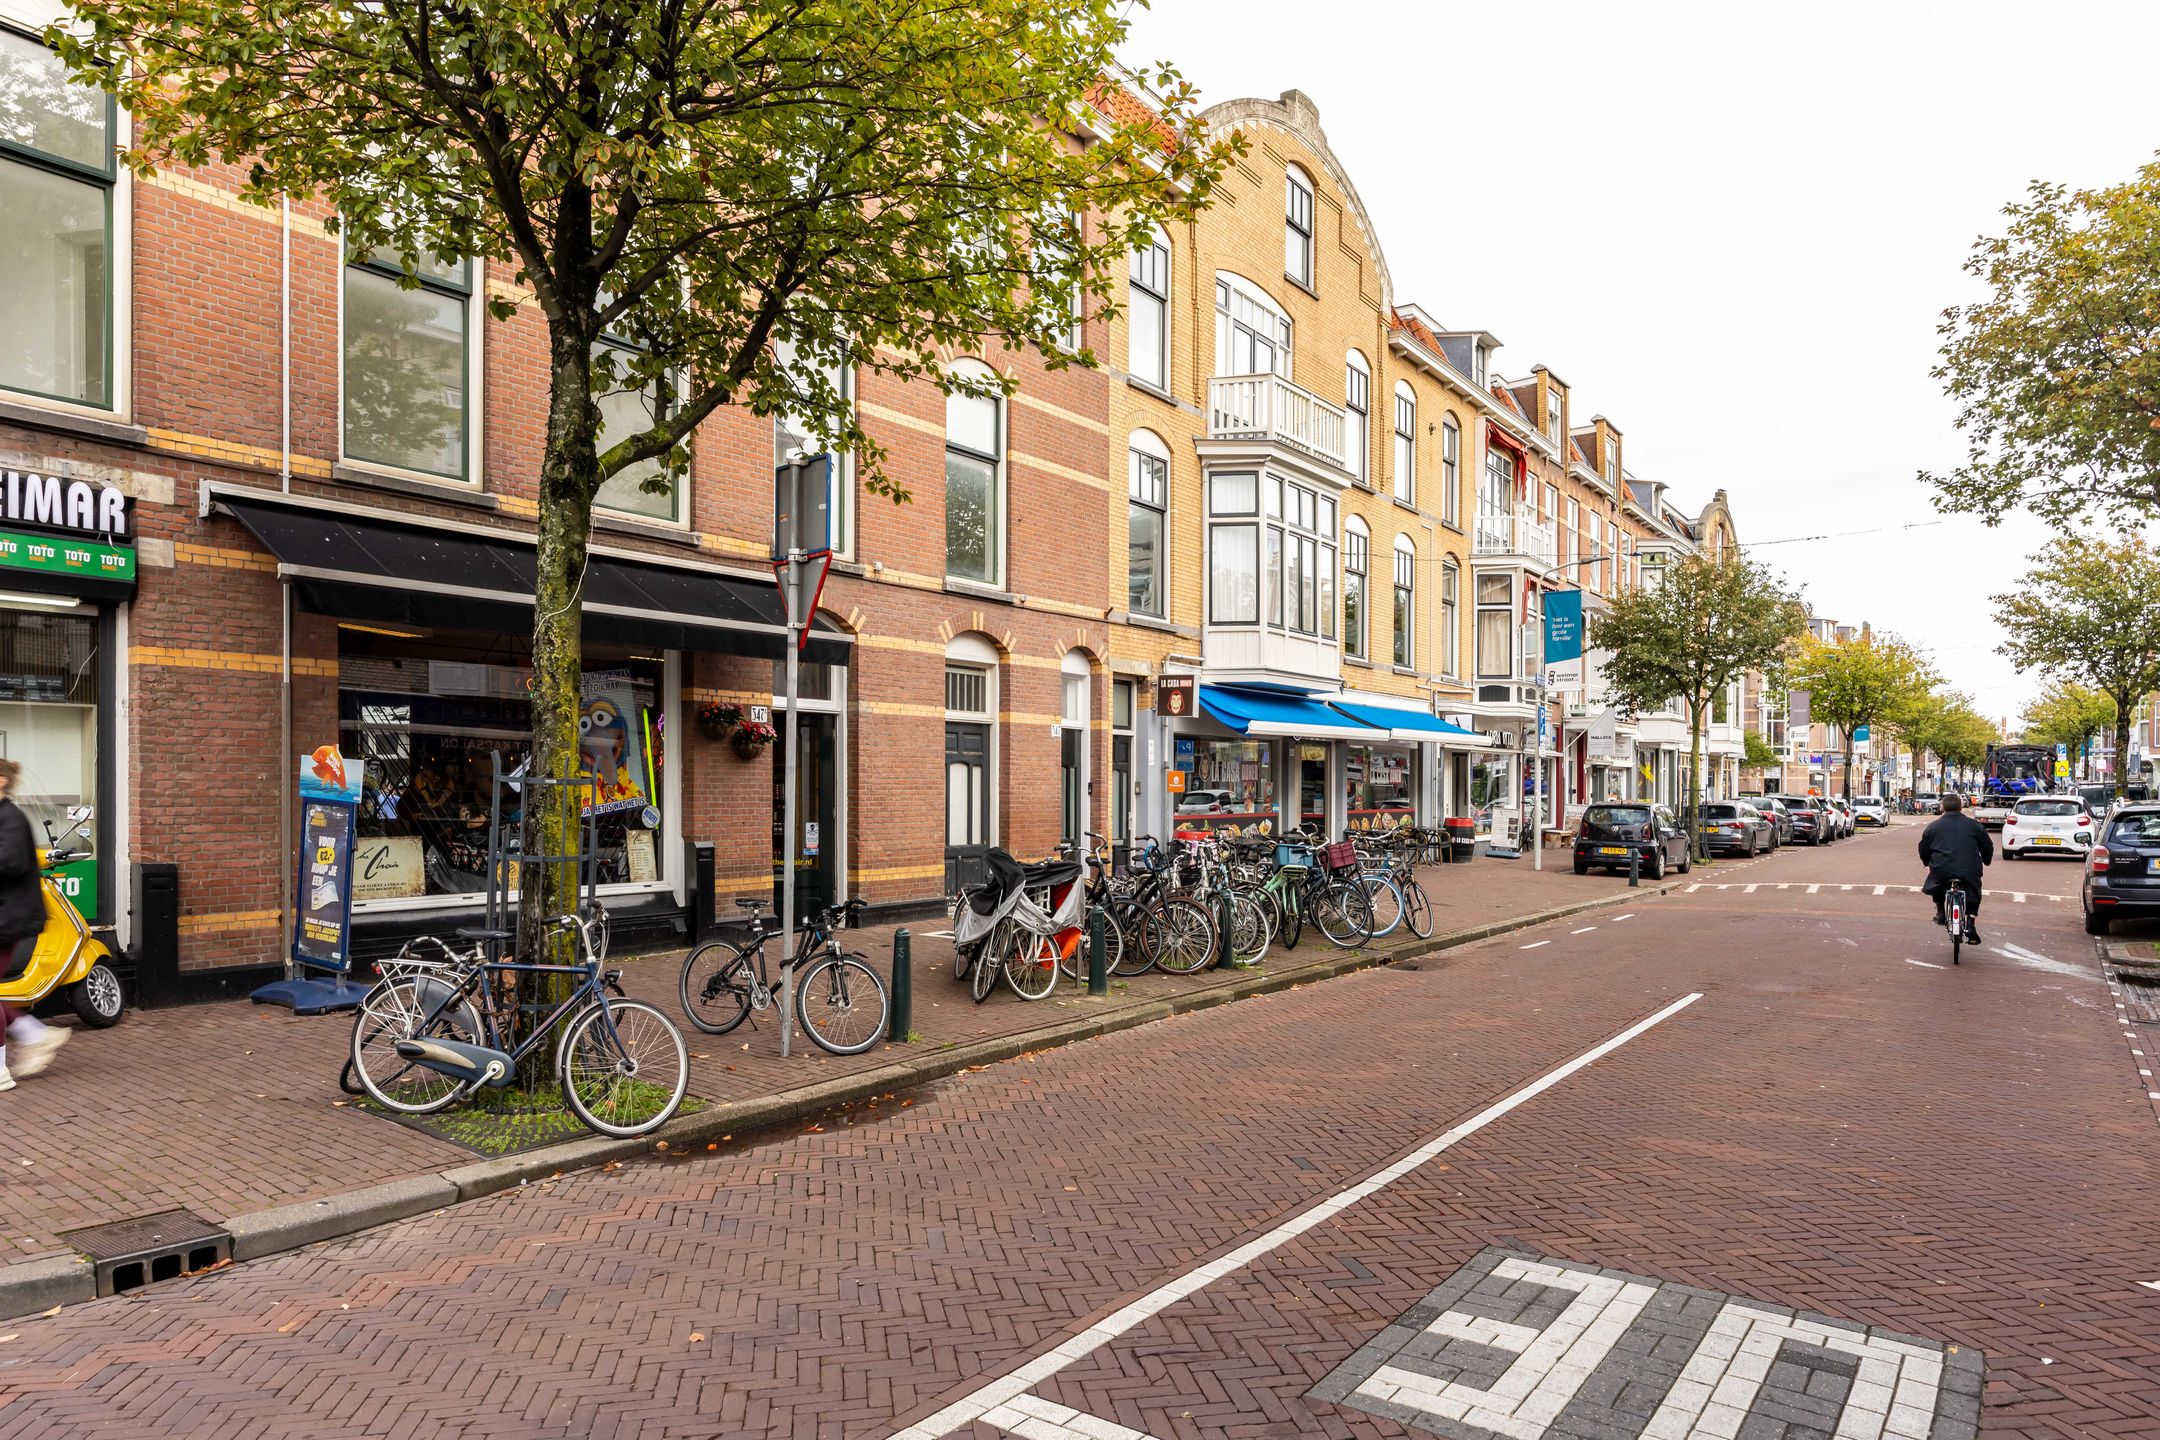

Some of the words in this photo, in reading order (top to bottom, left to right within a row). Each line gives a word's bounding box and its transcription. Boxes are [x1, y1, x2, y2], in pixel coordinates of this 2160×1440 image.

[0, 470, 125, 534] IMAR
[27, 545, 55, 557] TOTO
[64, 550, 91, 562] TOTO
[100, 555, 126, 566] TOTO
[1211, 761, 1220, 782] LA
[1221, 761, 1240, 782] CASA
[329, 865, 338, 877] JE
